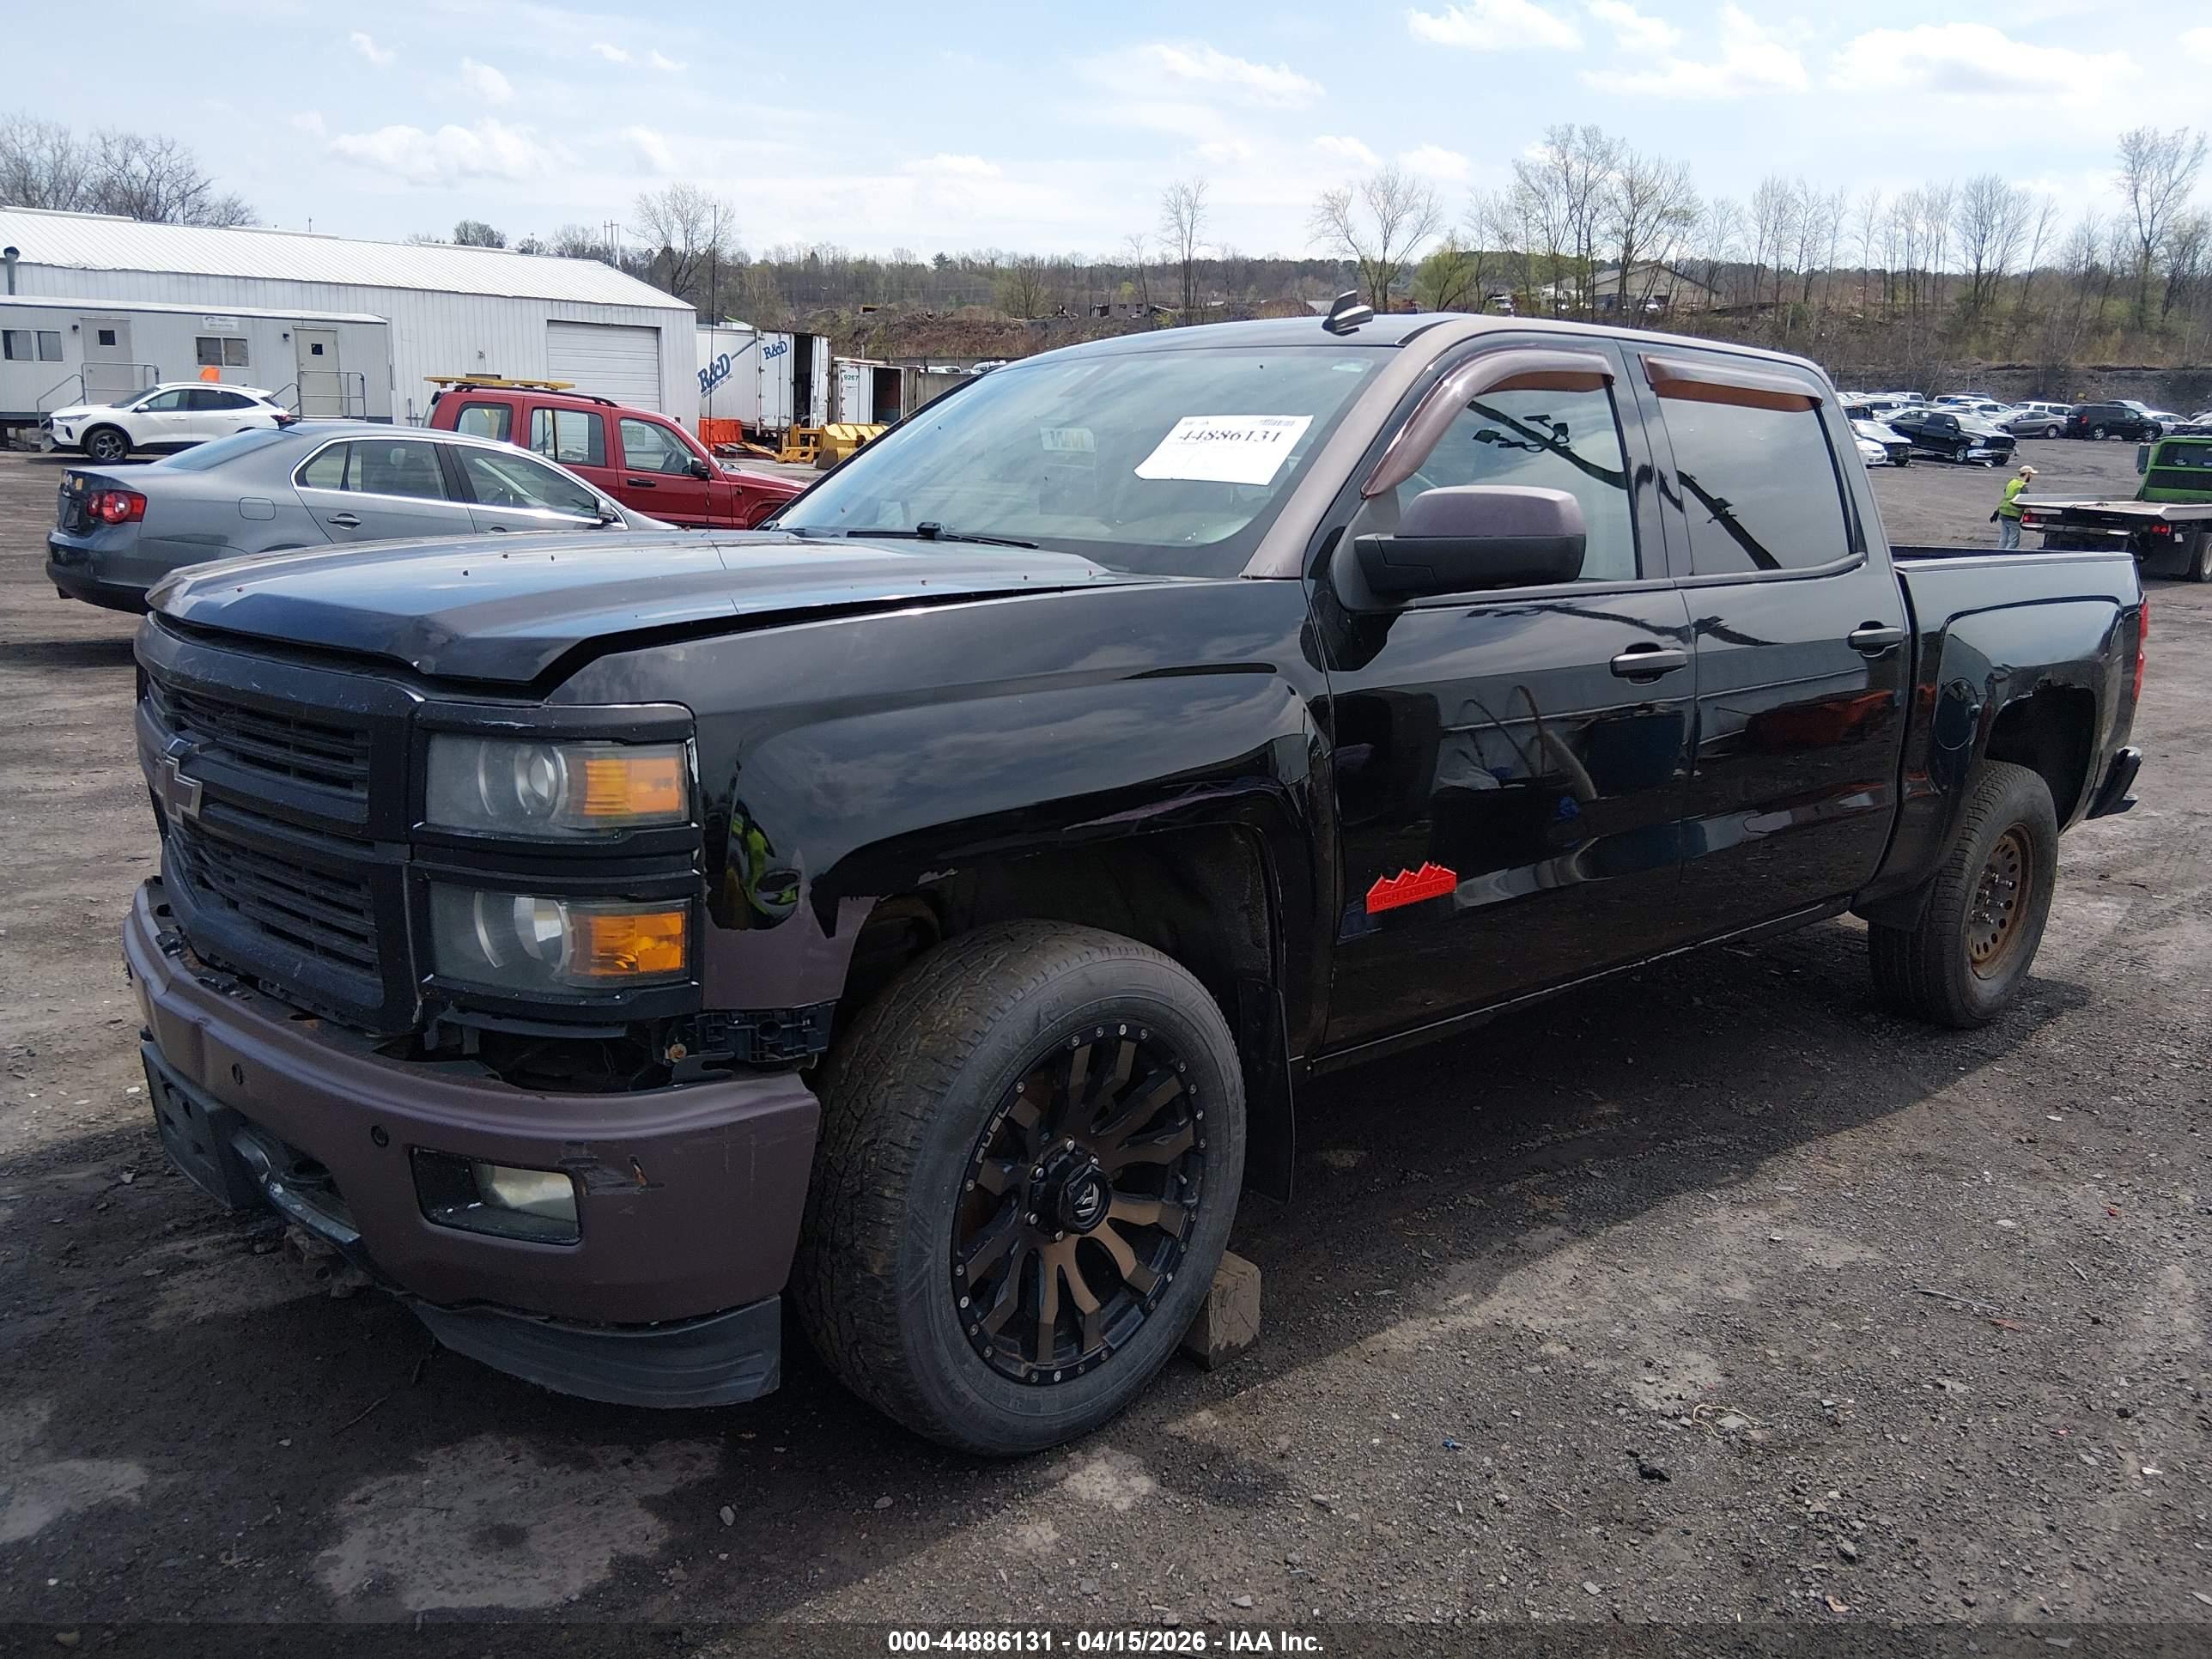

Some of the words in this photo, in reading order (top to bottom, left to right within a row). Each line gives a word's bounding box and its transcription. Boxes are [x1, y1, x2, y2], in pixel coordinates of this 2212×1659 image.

[763, 341, 787, 360] R&D
[698, 353, 730, 393] R&D
[1178, 429, 1282, 443] 44886131
[1374, 893, 1399, 906] HIGH
[975, 1105, 1011, 1164] FUEL
